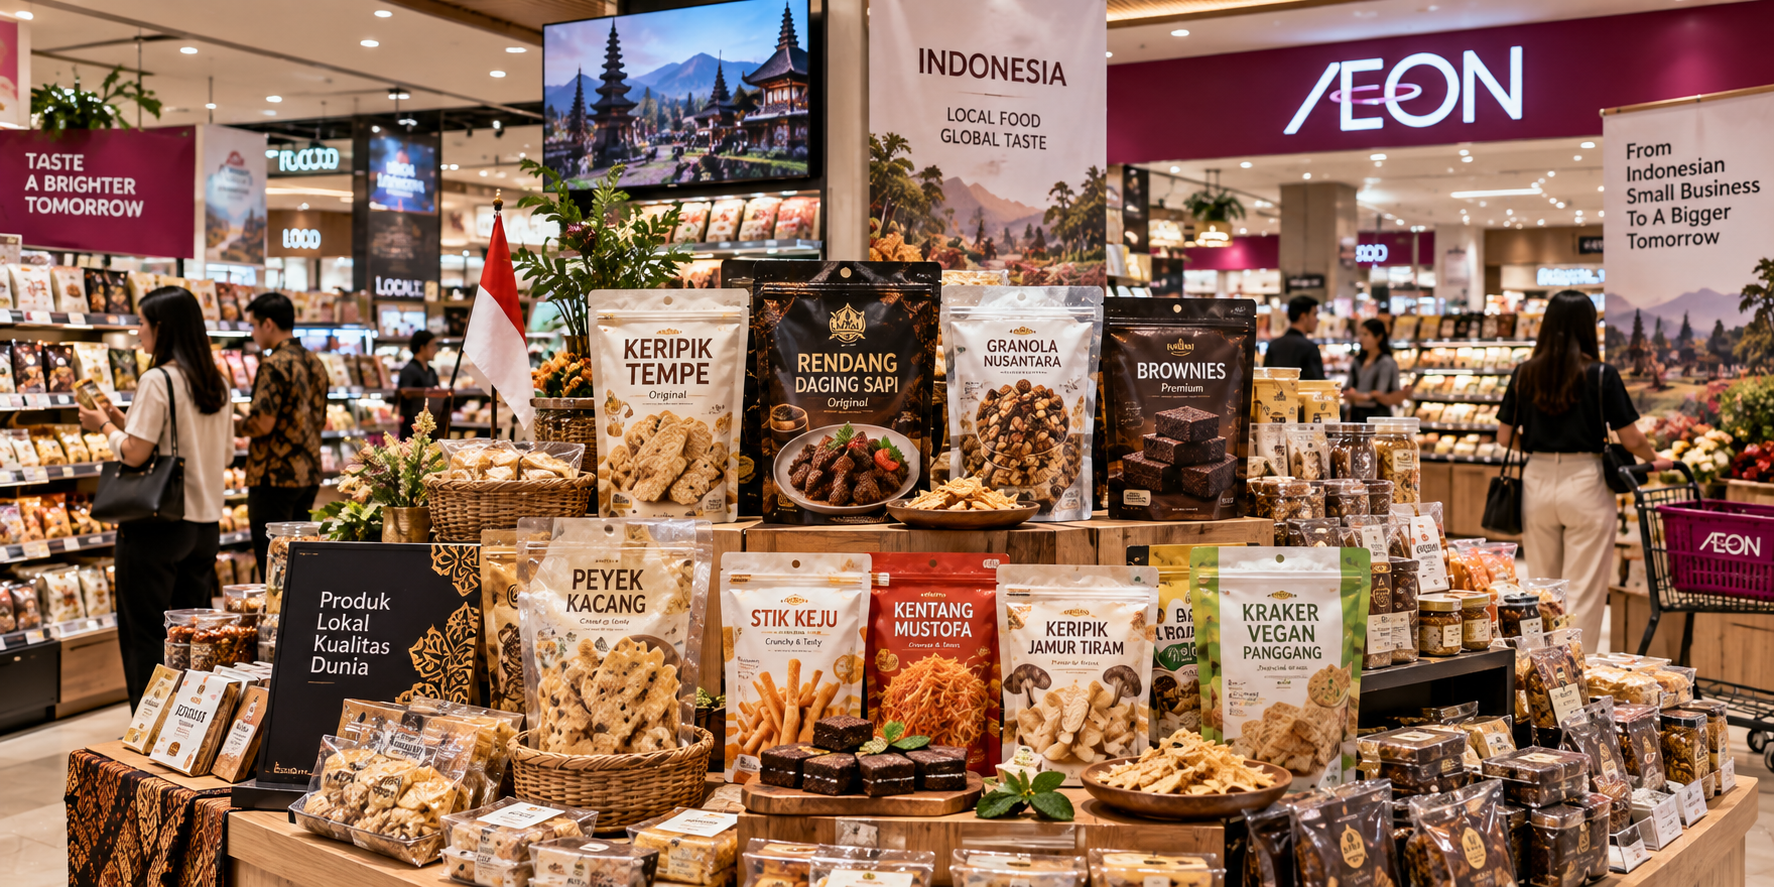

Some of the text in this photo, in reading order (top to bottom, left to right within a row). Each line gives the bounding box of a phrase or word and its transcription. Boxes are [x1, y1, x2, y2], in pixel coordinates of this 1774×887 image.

[918, 47, 1067, 87] INDONESIA
[947, 107, 1041, 128] LOCAL FOOD
[940, 128, 1047, 150] GLOBAL TASTE
[1626, 139, 1672, 160] From
[25, 152, 84, 172] TASTE
[1626, 157, 1725, 182] Indonesian
[25, 176, 136, 195] A BRIGHTER
[1626, 177, 1760, 205] Small Business
[25, 196, 144, 217] TOMORROW
[1626, 204, 1732, 227] To A Bigger
[1626, 229, 1720, 250] Tomorrow
[624, 338, 713, 359] KERIPIK
[987, 339, 1058, 354] GRANOLA
[797, 353, 898, 373] RENDANG
[984, 355, 1061, 368] NUSANTARA
[1137, 362, 1226, 380] BROWNIES
[626, 363, 710, 385] TEMPE
[795, 376, 899, 393] DAGING SAPI
[1161, 383, 1204, 393] Premium
[649, 390, 687, 402] Original
[827, 397, 869, 409] Original
[572, 569, 644, 590] PEYEK
[319, 591, 391, 611] Produk
[566, 594, 646, 613] KACANG
[894, 602, 973, 619] KENTANG
[751, 609, 838, 628] STIK KEJU
[1243, 603, 1320, 622] KRAKER
[316, 613, 370, 632] Lokal
[894, 621, 972, 638] MUSTOFA
[1046, 621, 1109, 638] KERIPIK
[1247, 624, 1315, 643] VEGAN
[313, 634, 390, 655] Kualitas
[1028, 640, 1124, 656] JAMUR TIRAM
[1243, 645, 1322, 660] PANGGANG
[310, 656, 369, 676] Dunia
